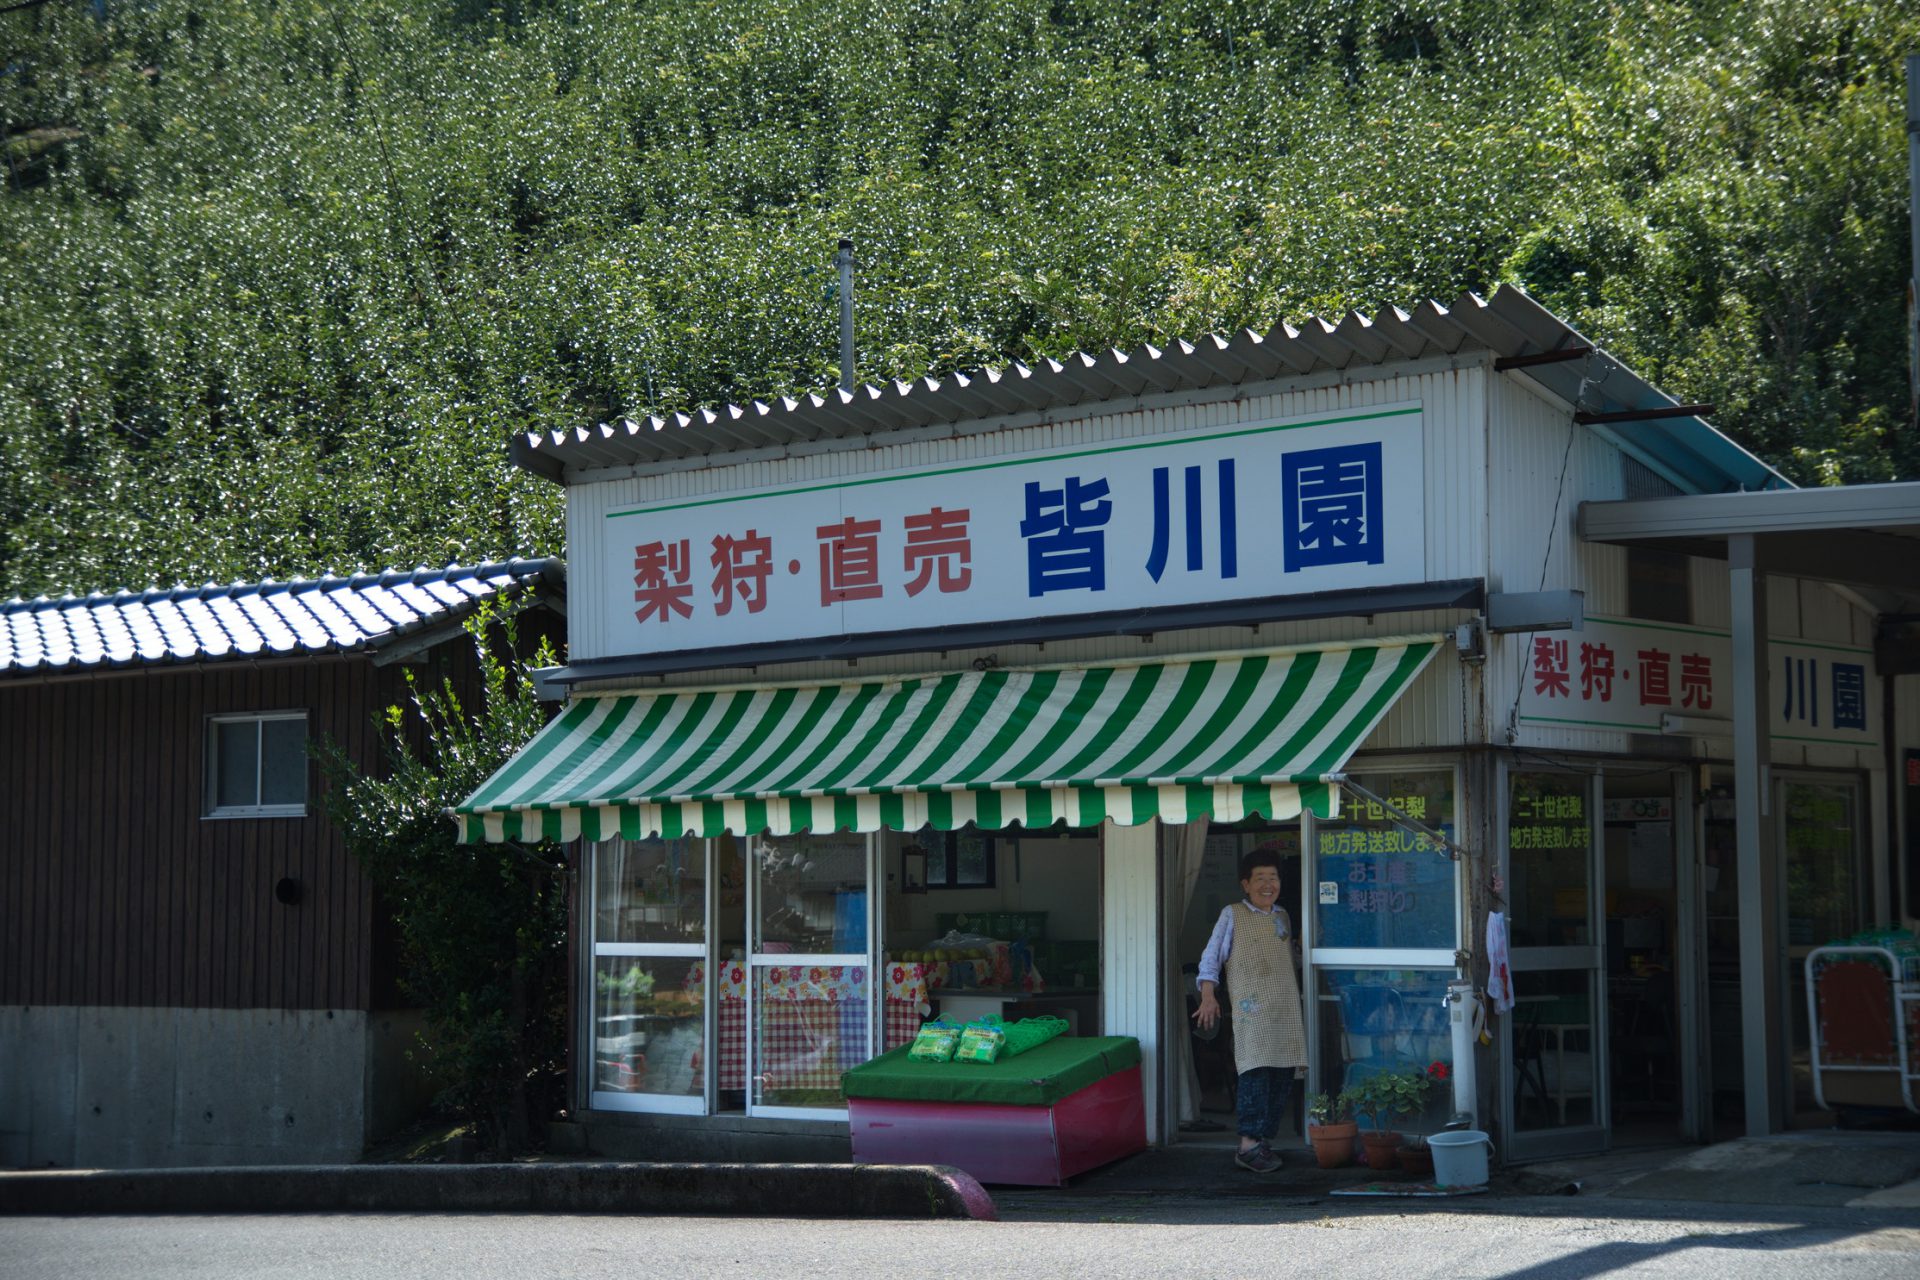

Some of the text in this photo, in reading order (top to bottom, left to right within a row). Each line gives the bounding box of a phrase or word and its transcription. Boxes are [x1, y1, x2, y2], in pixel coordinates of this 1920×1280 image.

[634, 441, 1385, 625] 梨狩・直売 皆川園
[1533, 637, 1713, 710] 梨狩・直売
[1518, 795, 1583, 819] 二十世紀梨
[1510, 826, 1592, 849] 地方発送致します
